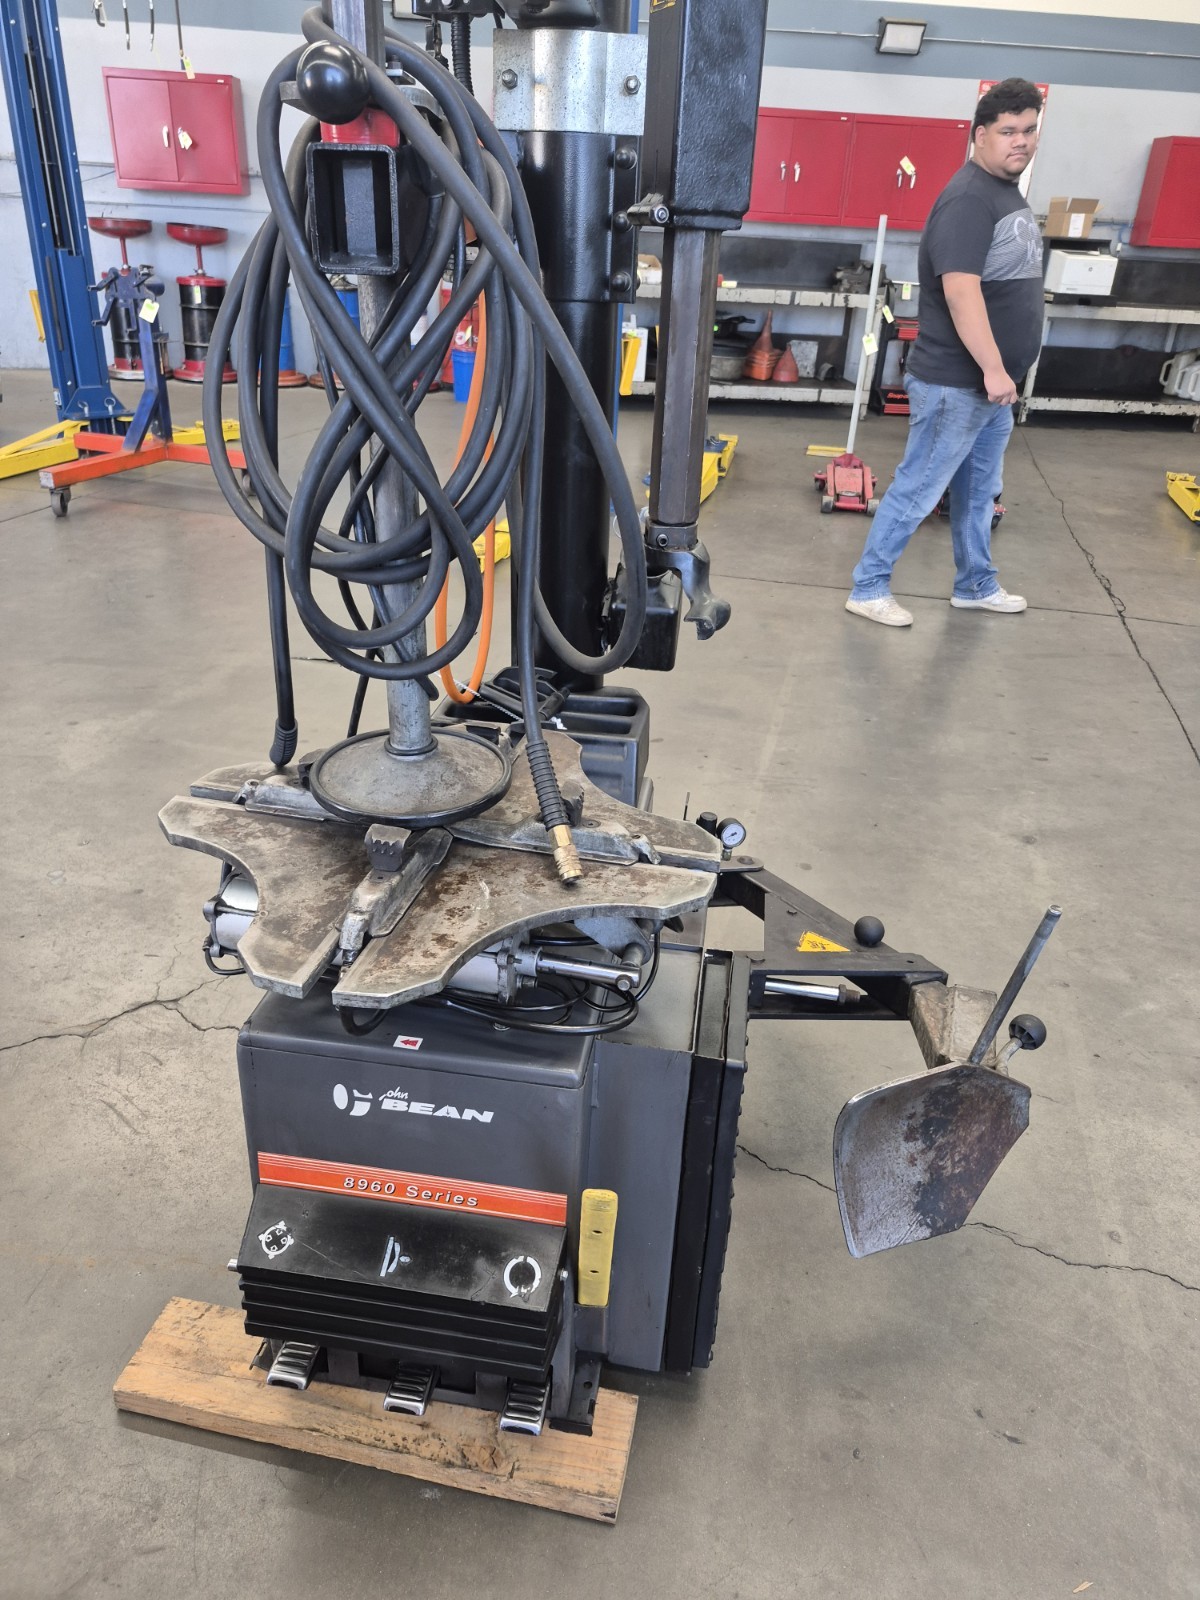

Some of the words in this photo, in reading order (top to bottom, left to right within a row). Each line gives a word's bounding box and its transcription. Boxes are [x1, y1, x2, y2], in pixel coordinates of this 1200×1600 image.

[381, 1098, 494, 1123] BEAN
[343, 1177, 396, 1195] 8960
[406, 1185, 478, 1206] Series
